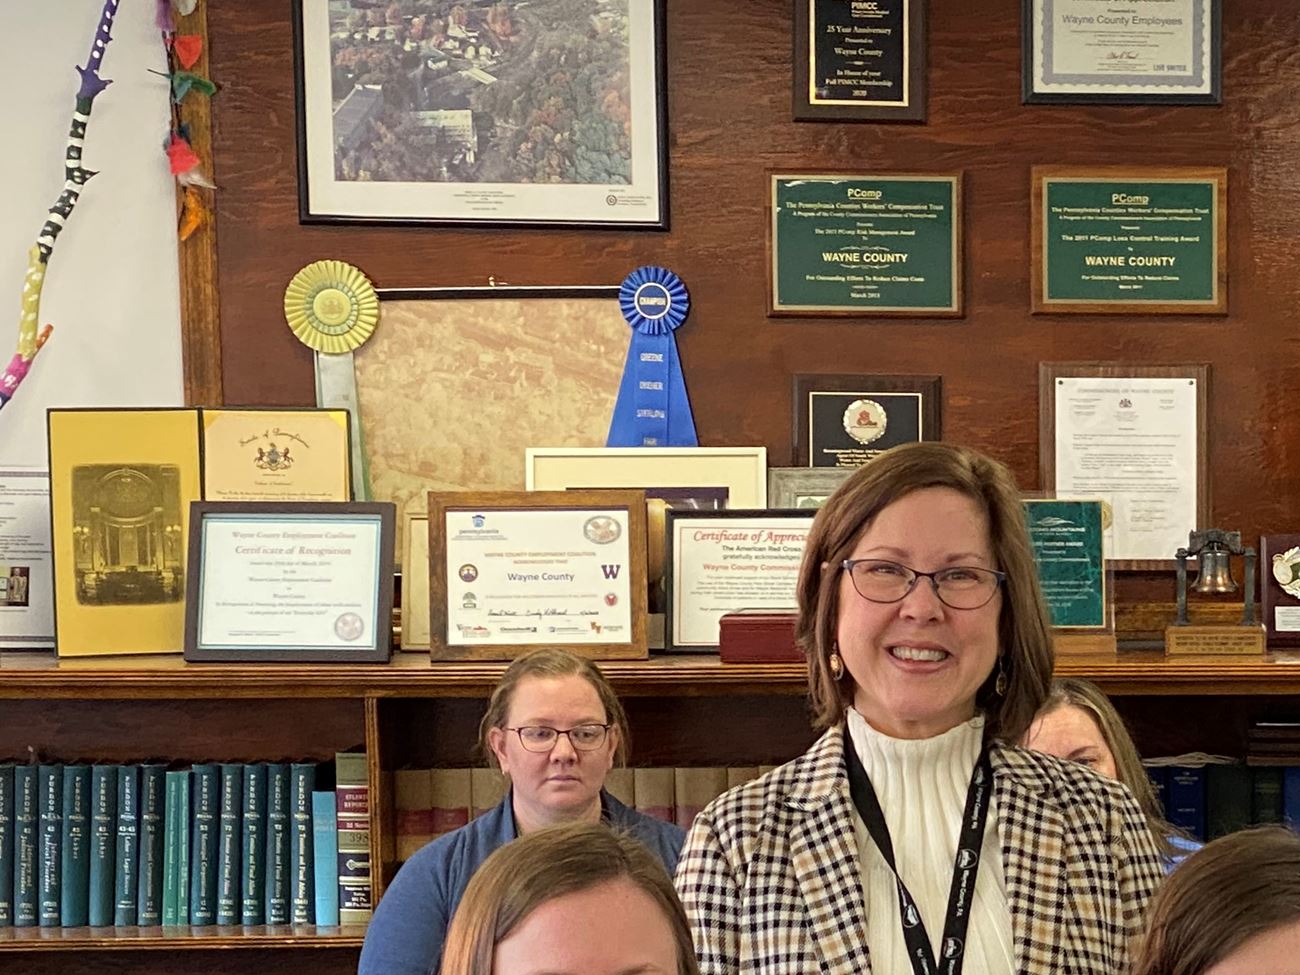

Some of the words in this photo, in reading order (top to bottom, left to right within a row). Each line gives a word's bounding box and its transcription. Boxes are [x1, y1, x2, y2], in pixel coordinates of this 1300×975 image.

[1062, 15, 1094, 26] Wayne
[1096, 15, 1129, 26] County
[1132, 16, 1183, 27] Employees
[827, 25, 835, 33] 25
[853, 26, 891, 35] Anniversary
[834, 48, 857, 56] Wayne
[858, 49, 883, 57] County
[847, 189, 882, 198] PComp
[1112, 193, 1149, 204] PComp
[798, 202, 834, 211] Pennsylvania
[888, 203, 927, 211] Compensation
[929, 203, 944, 211] Trust
[823, 252, 860, 262] WAYNE
[863, 253, 908, 263] COUNTY
[1085, 256, 1125, 266] WAYNE
[1128, 256, 1175, 266] COUNTY
[232, 531, 255, 539] Wayne
[256, 531, 280, 540] County
[694, 530, 747, 544] Certificate
[751, 530, 765, 544] of
[235, 545, 283, 555] Certificate
[285, 546, 295, 555] of
[298, 546, 351, 557] Recognition
[601, 564, 621, 579] W
[703, 563, 729, 571] Wayne
[507, 572, 540, 582] Wayne
[541, 572, 575, 582] County
[961, 870, 969, 887] Wayne
